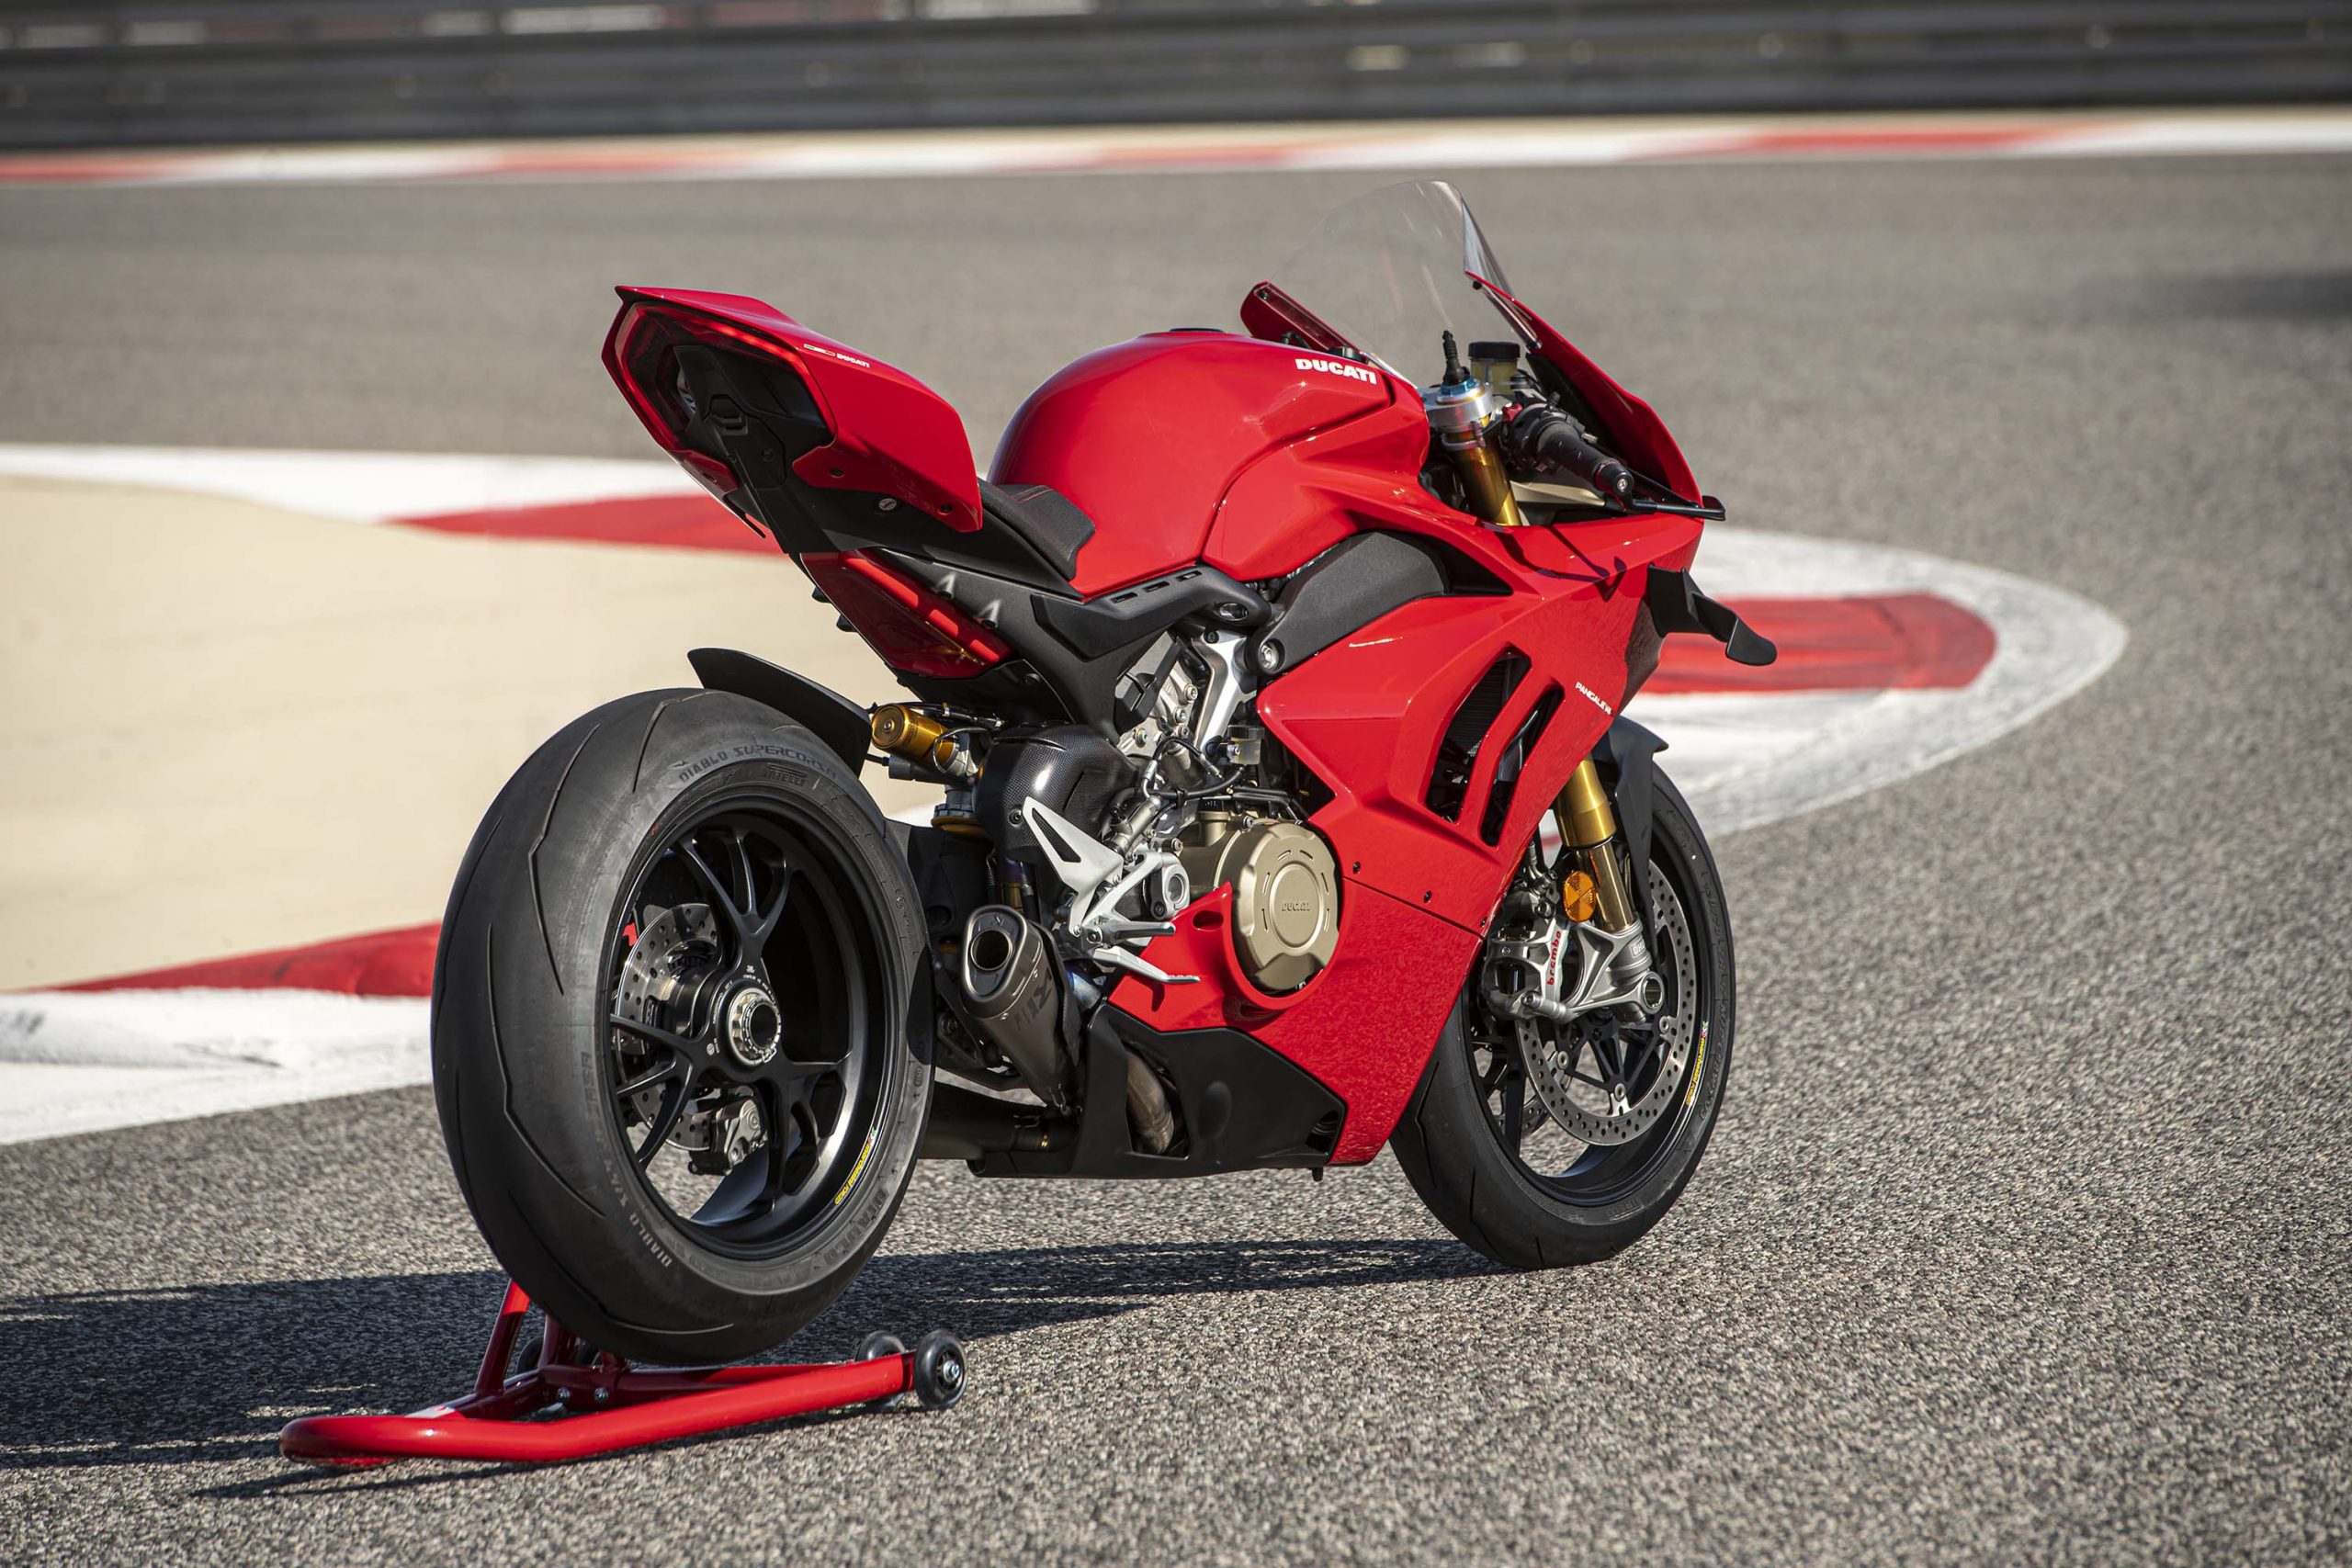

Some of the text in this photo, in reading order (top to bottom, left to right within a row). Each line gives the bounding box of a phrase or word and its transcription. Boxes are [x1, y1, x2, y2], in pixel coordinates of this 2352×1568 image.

[1295, 358, 1377, 385] DUCATI
[679, 745, 838, 783] DIABLO SUPERCORSA
[1546, 931, 1562, 986] brembo
[629, 1213, 673, 1268] DIABLO
